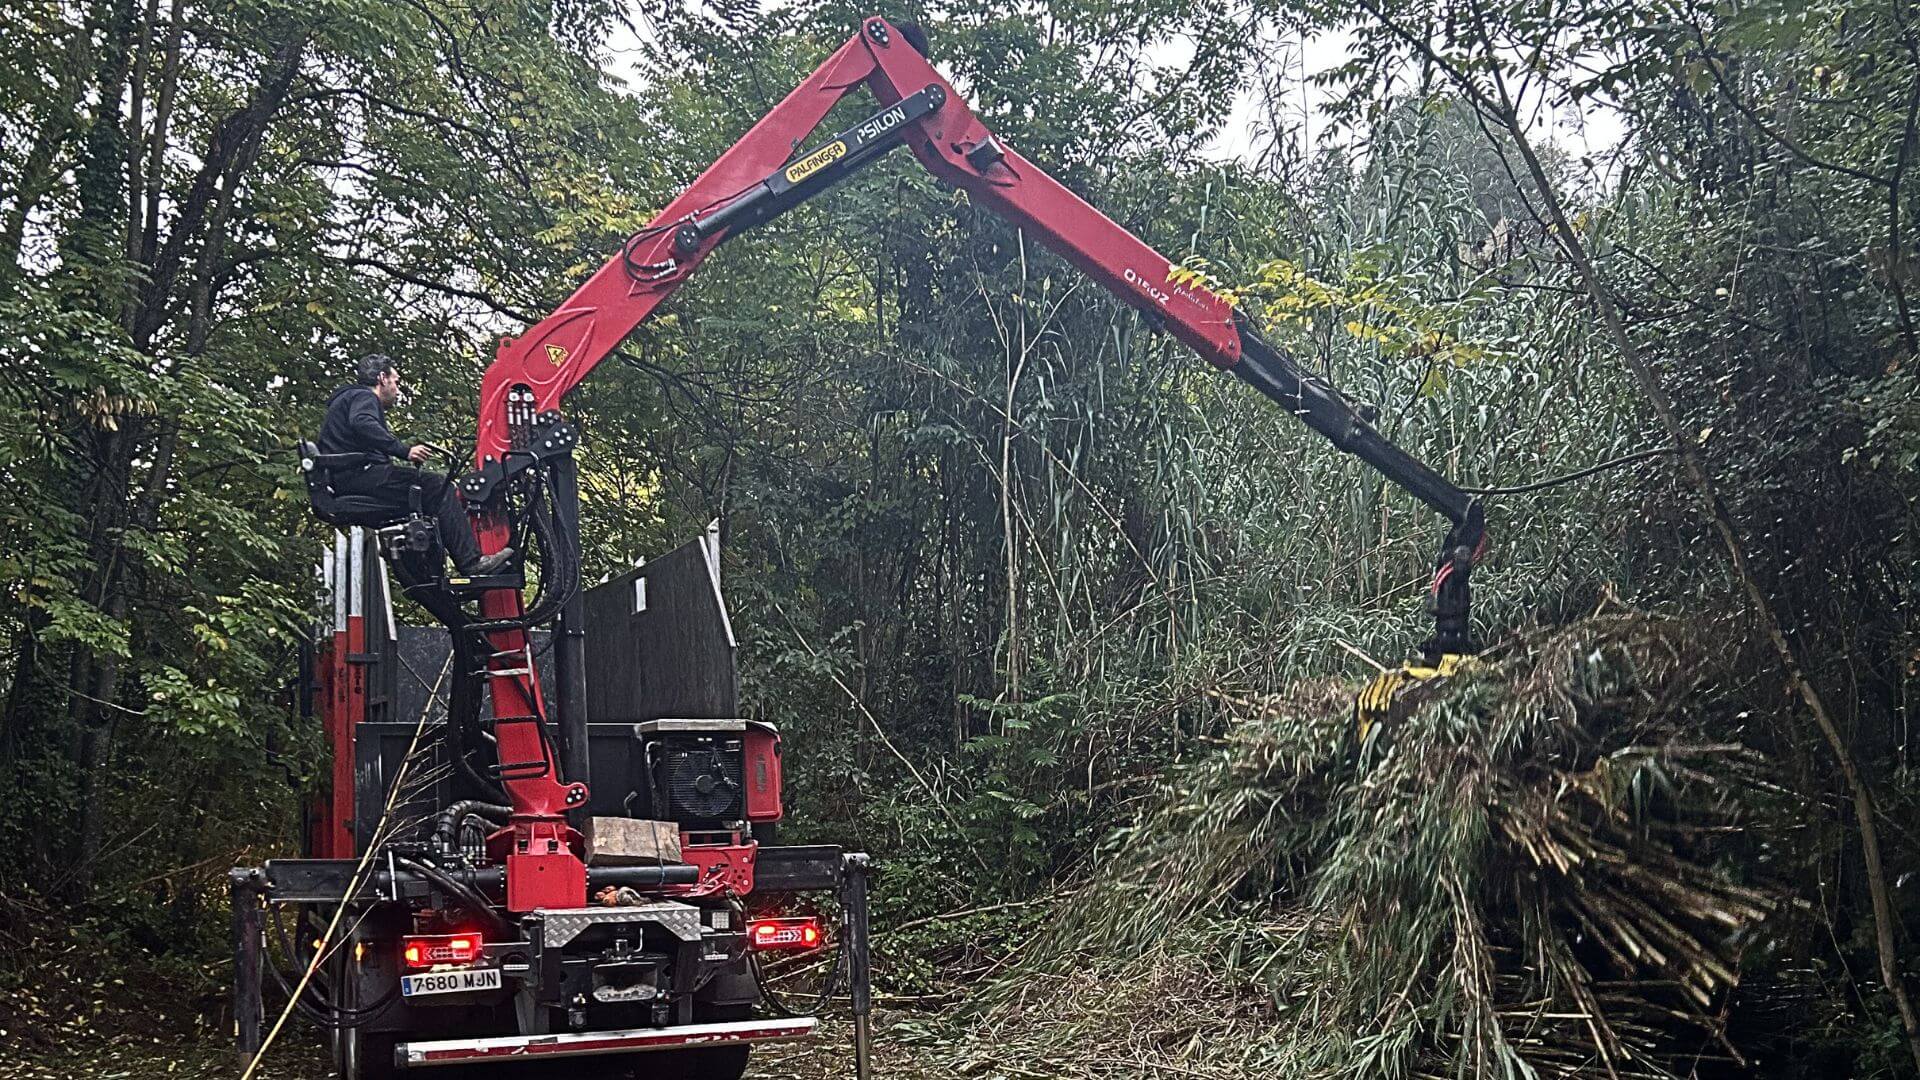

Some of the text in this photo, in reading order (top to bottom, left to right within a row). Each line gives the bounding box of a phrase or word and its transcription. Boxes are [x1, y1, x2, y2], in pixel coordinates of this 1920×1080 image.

[789, 143, 843, 180] PALFINGER
[413, 971, 497, 993] 7680 MJN
